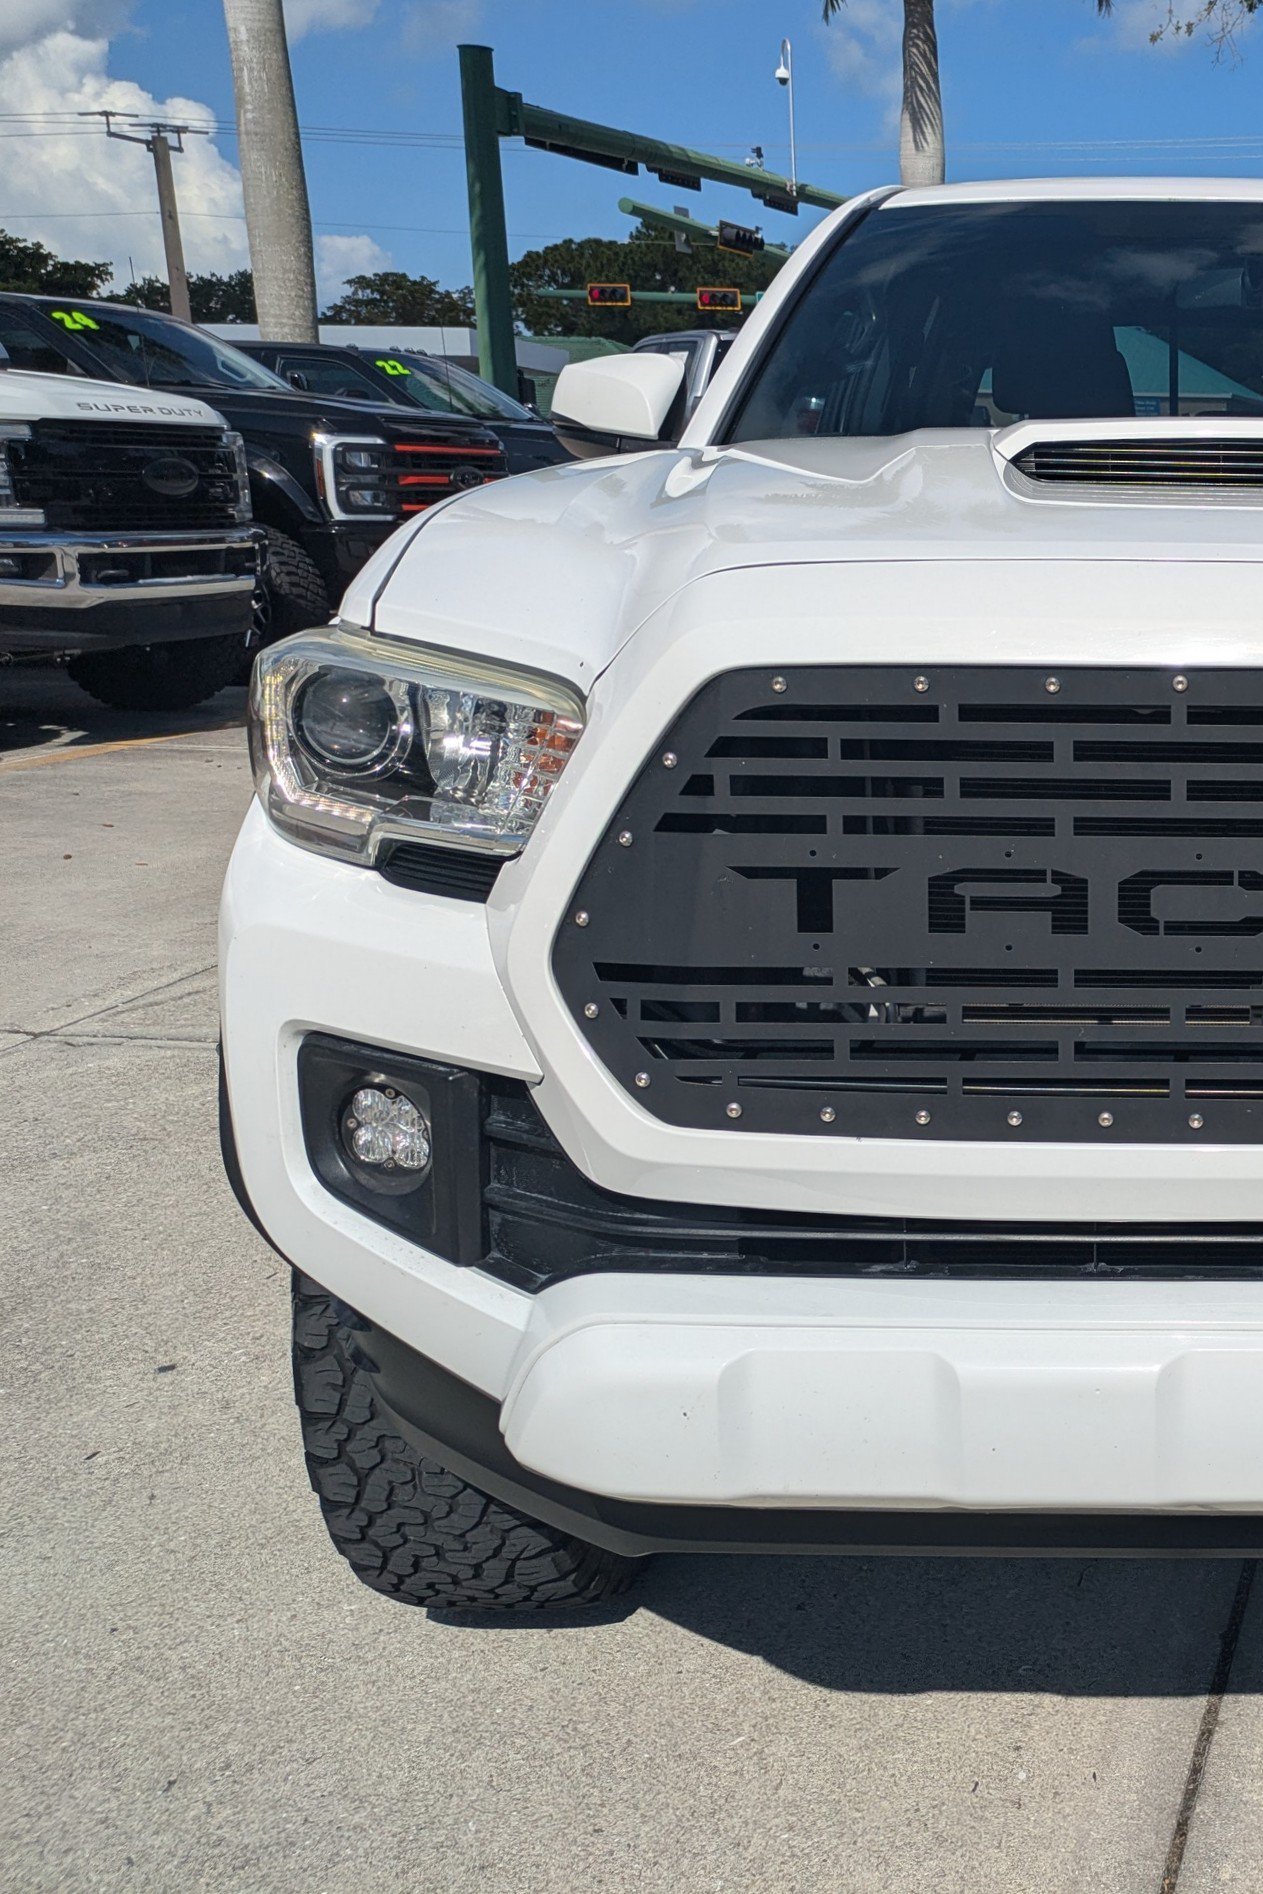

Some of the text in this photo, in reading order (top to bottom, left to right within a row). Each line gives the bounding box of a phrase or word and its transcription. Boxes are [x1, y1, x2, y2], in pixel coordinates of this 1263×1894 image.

[375, 360, 411, 375] 22
[76, 402, 204, 417] SUPER DUTY
